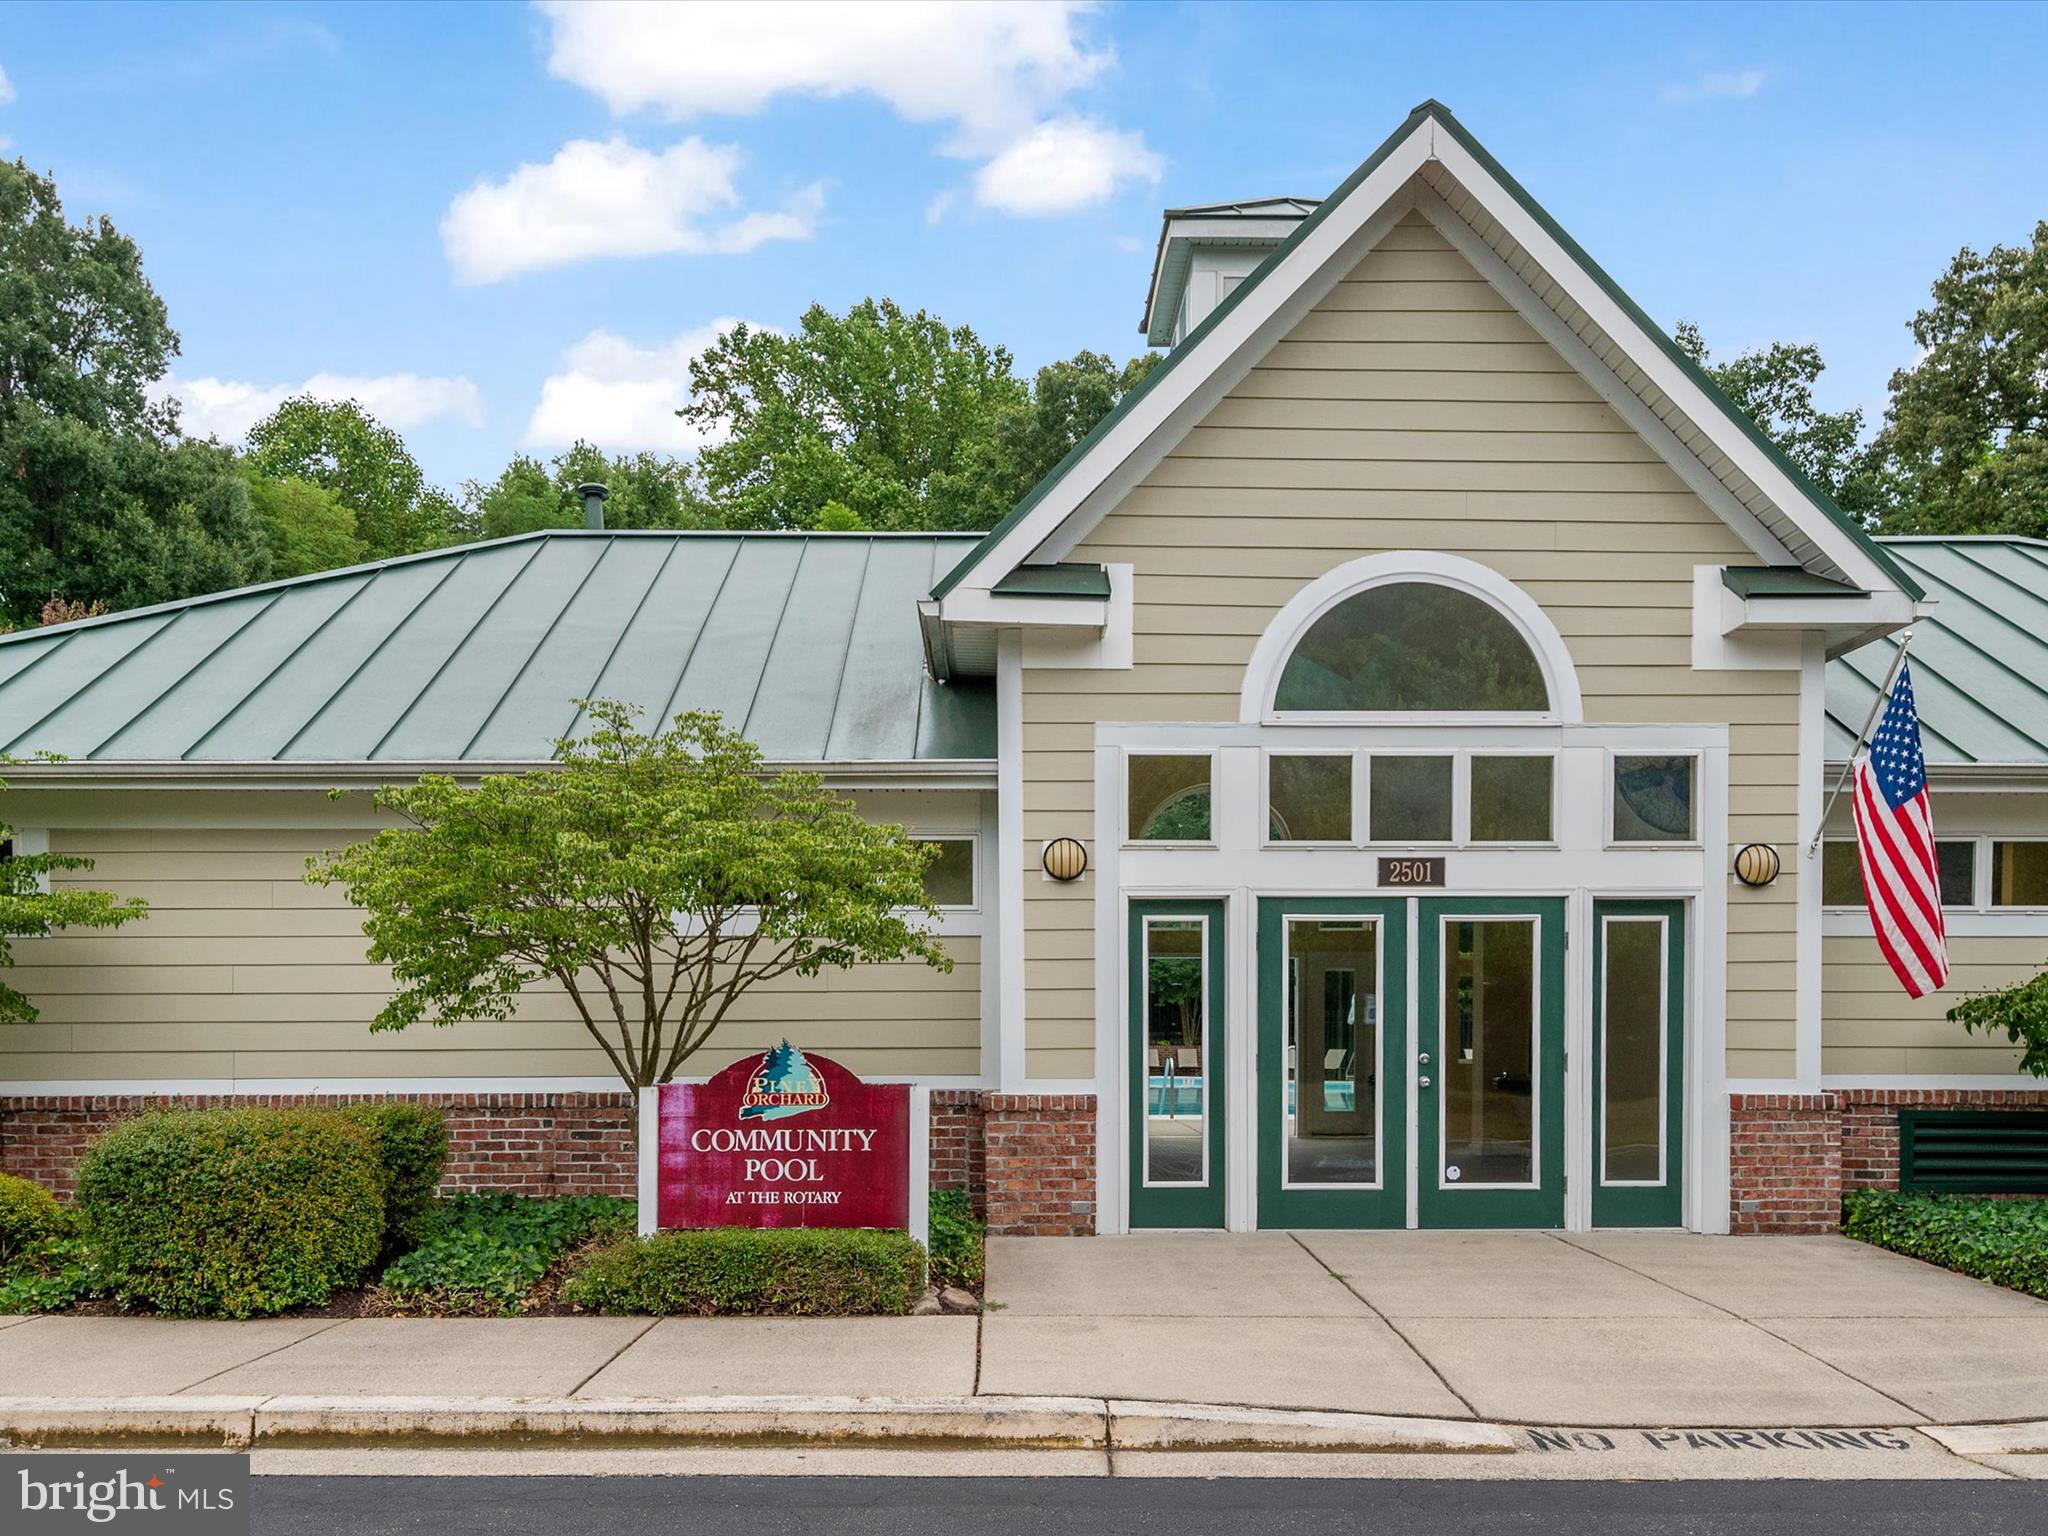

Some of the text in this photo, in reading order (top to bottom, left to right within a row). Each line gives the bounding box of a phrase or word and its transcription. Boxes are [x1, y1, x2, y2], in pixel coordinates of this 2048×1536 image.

[1389, 861, 1432, 882] 2501
[752, 1077, 824, 1093] PINEY
[746, 1093, 826, 1105] ORCHARD
[691, 1129, 877, 1152] COMMUNITY
[744, 1159, 824, 1181] POOL
[725, 1191, 842, 1204] AT THE ROTARY
[1525, 1429, 1911, 1451] NO PARKING
